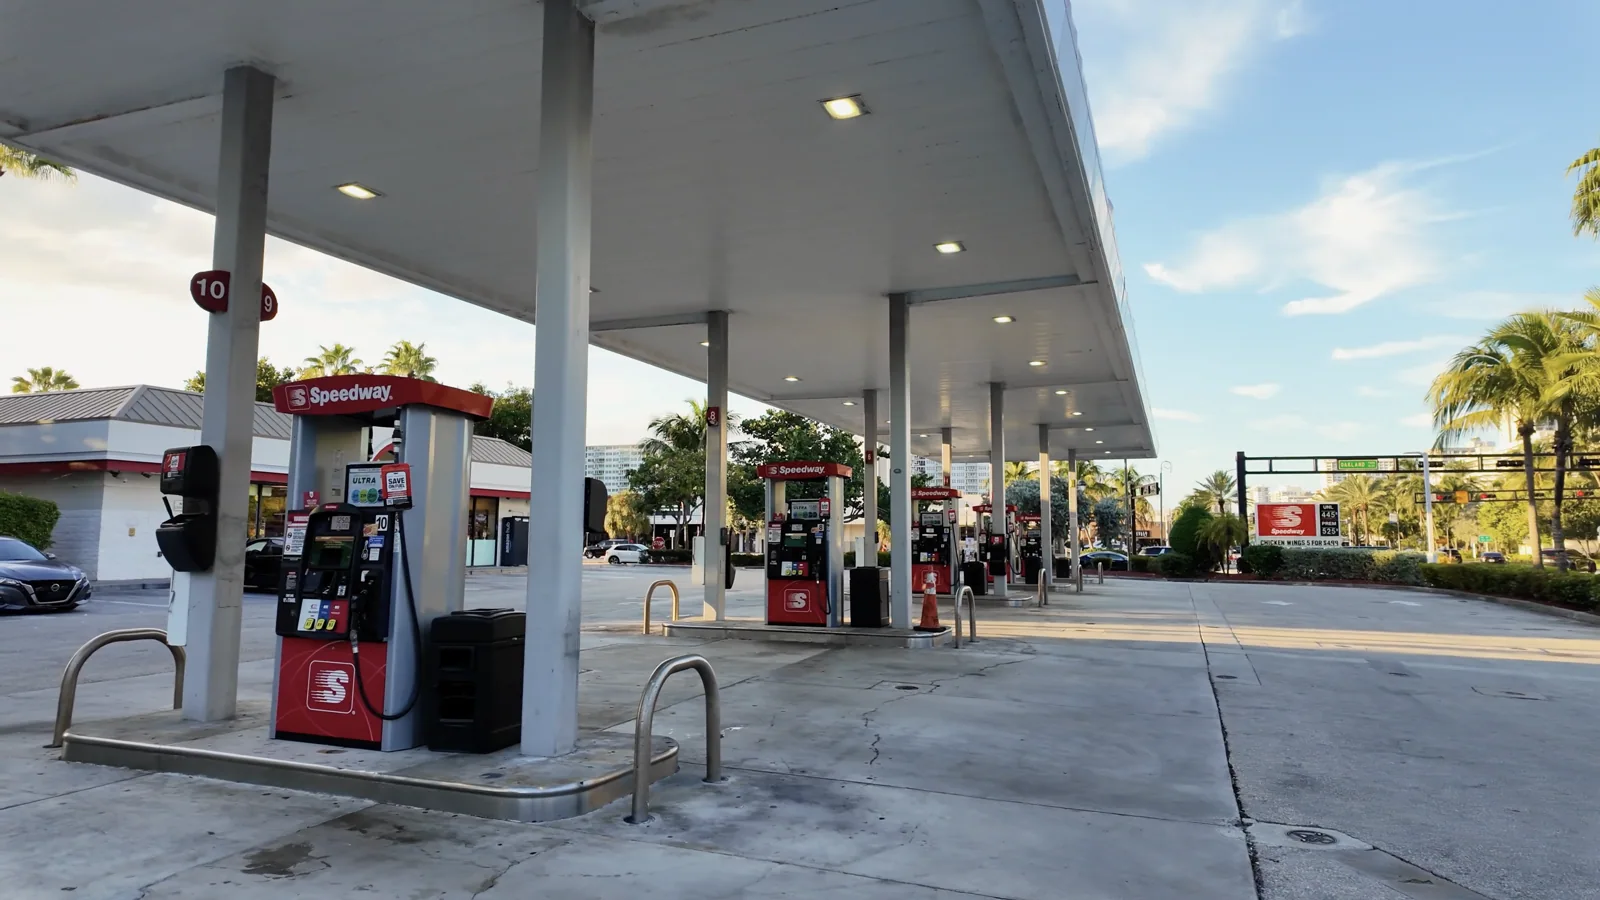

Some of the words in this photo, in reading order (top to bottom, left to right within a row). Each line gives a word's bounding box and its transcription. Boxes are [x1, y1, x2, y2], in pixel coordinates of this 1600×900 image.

[197, 279, 225, 299] 10
[264, 295, 272, 312] 9
[310, 384, 392, 406] Speedway
[780, 465, 825, 475] Speedway
[388, 477, 405, 485] SAVE
[376, 516, 387, 530] 10
